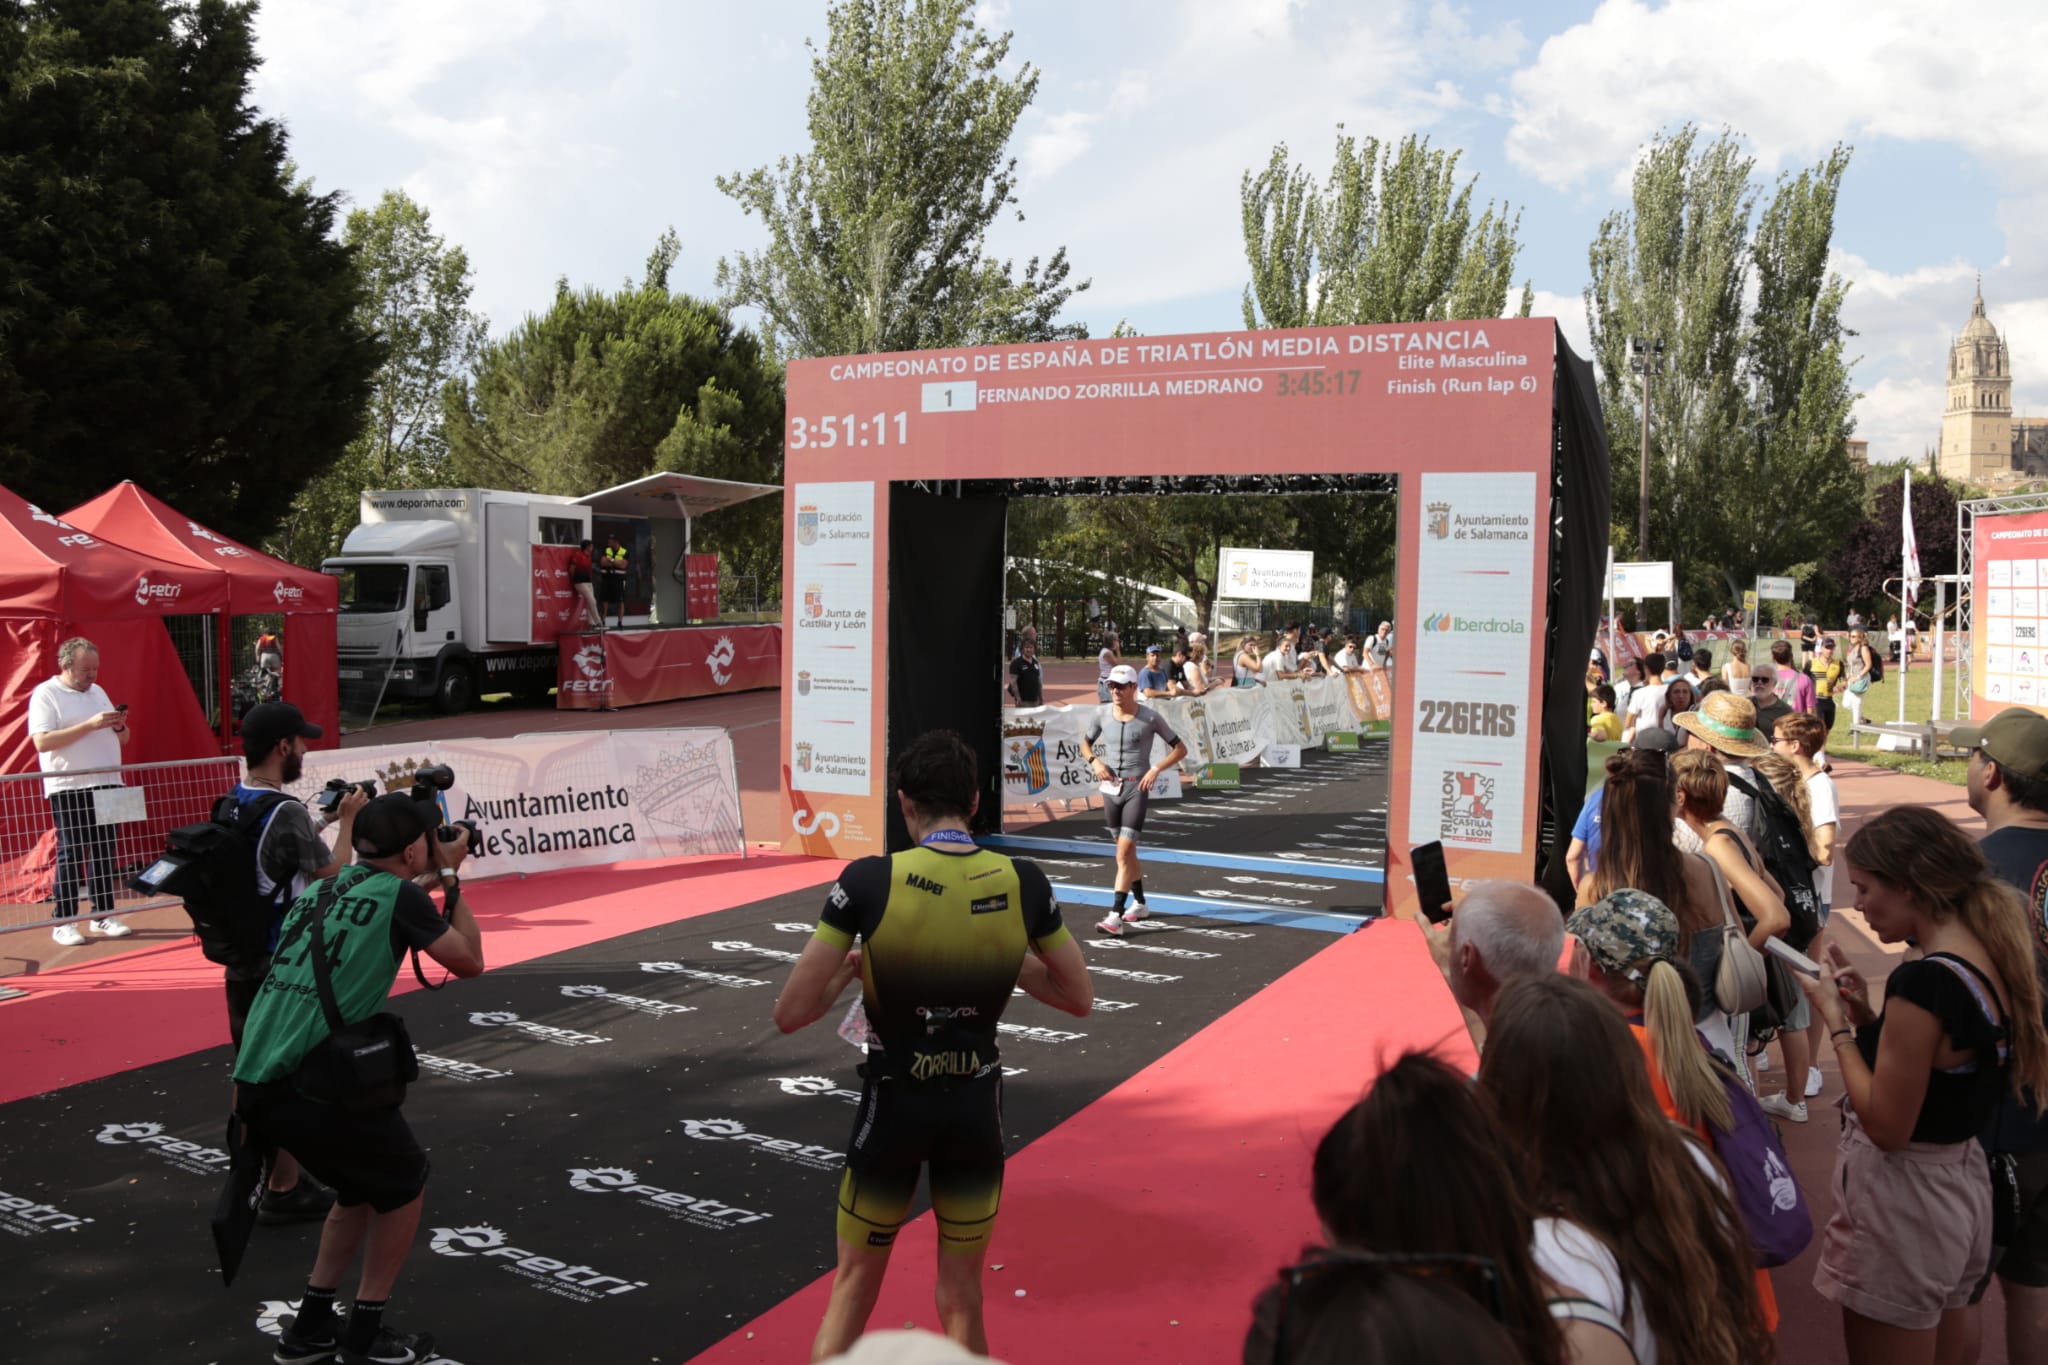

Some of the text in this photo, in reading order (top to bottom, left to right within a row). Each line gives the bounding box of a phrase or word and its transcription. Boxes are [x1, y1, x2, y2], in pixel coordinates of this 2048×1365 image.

[830, 329, 1490, 381] CAMPEONATO DE ESPAÑA DE TRIATLÓN MEDIA DISTANCIA
[1398, 351, 1527, 370] Elite Masculina
[944, 370, 1361, 408] 1 FERNANDO ZORRILLA MEDRANO 3:45:17
[1387, 376, 1538, 395] Finish (Run lap 6)
[790, 410, 907, 449] 3:51:11
[371, 498, 465, 511] www.deporama.com
[819, 512, 862, 523] Diputación
[1454, 514, 1529, 527] Ayuntamiento
[828, 529, 870, 540] Salamanca
[1454, 528, 1529, 540] de Salamanca
[1251, 567, 1307, 578] Ayuntamiento
[1251, 578, 1306, 589] de Salamanca
[825, 609, 866, 618] Junta de
[799, 619, 831, 629] Castilla
[843, 619, 866, 630] León
[1454, 617, 1524, 633] Iberdrola
[1418, 699, 1516, 737] 226ERS
[815, 752, 866, 766] Ayuntamiento
[814, 763, 866, 777] de Salamanca
[1060, 764, 1079, 786] de
[464, 785, 629, 825] Ayuntamiento
[1452, 817, 1493, 829] CASTILLA
[502, 822, 636, 856] Salamanca
[906, 872, 944, 896] MAPEI
[910, 1051, 981, 1080] ZORRILLA
